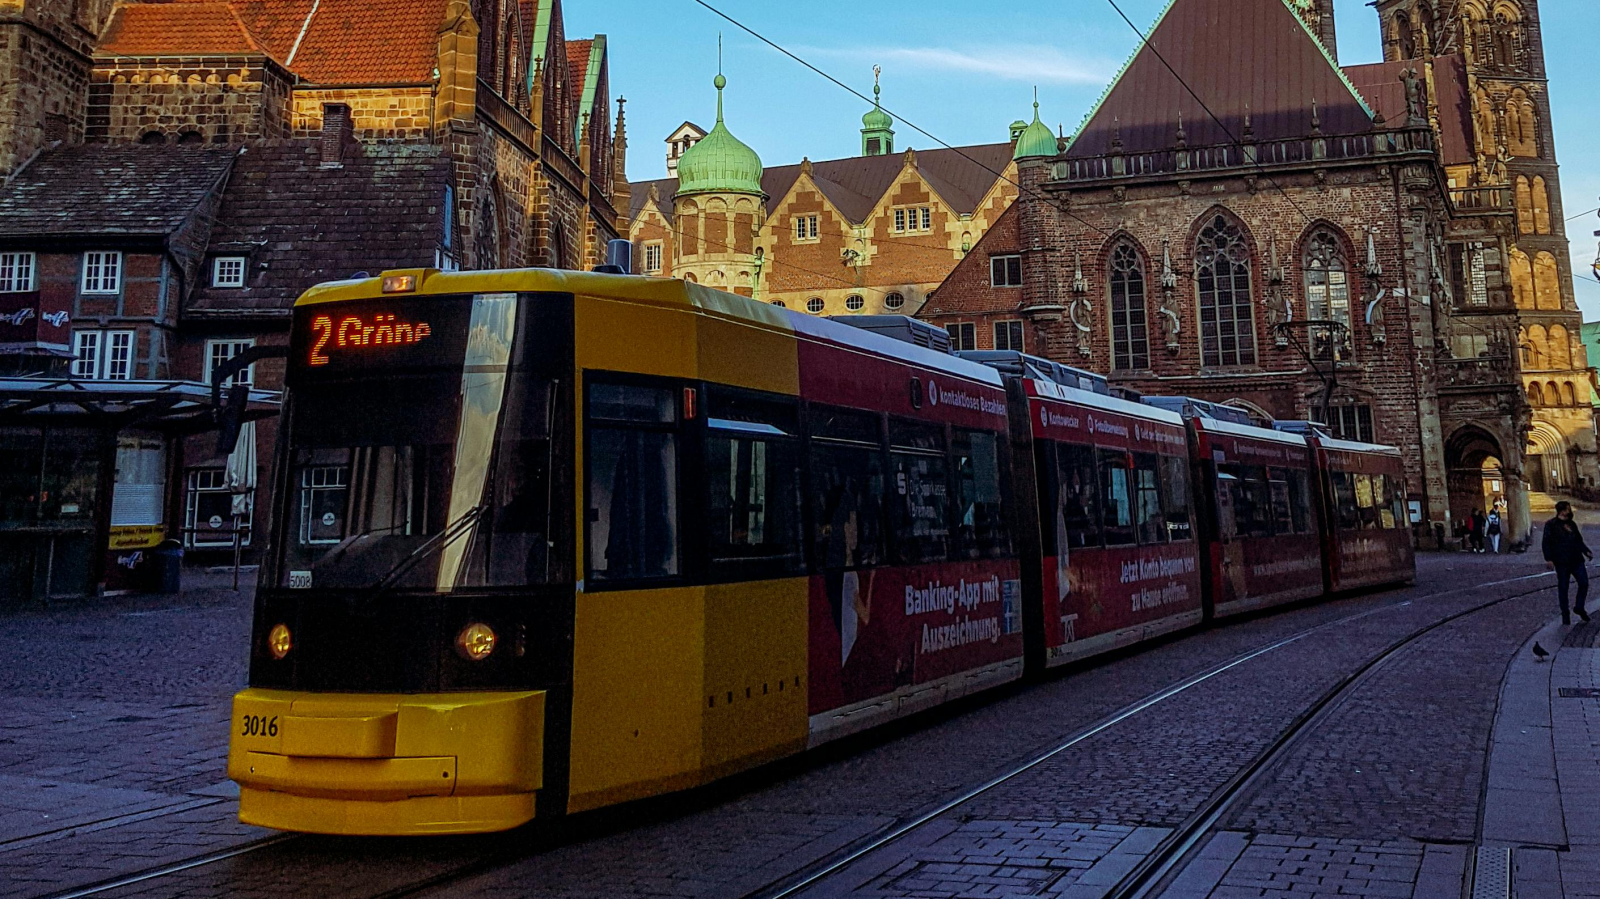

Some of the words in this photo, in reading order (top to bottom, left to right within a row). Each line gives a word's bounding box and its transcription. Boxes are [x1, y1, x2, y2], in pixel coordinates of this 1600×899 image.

[310, 315, 332, 365] 2
[290, 575, 312, 588] 5008
[1120, 560, 1139, 584] Jetzt
[1139, 558, 1159, 581] Konto
[904, 578, 981, 615] Banking-App
[982, 574, 1000, 604] mit
[1131, 593, 1141, 612] zu
[1141, 587, 1162, 609] Hause
[920, 614, 1001, 655] Auszeichnung.
[241, 714, 279, 737] 3016
